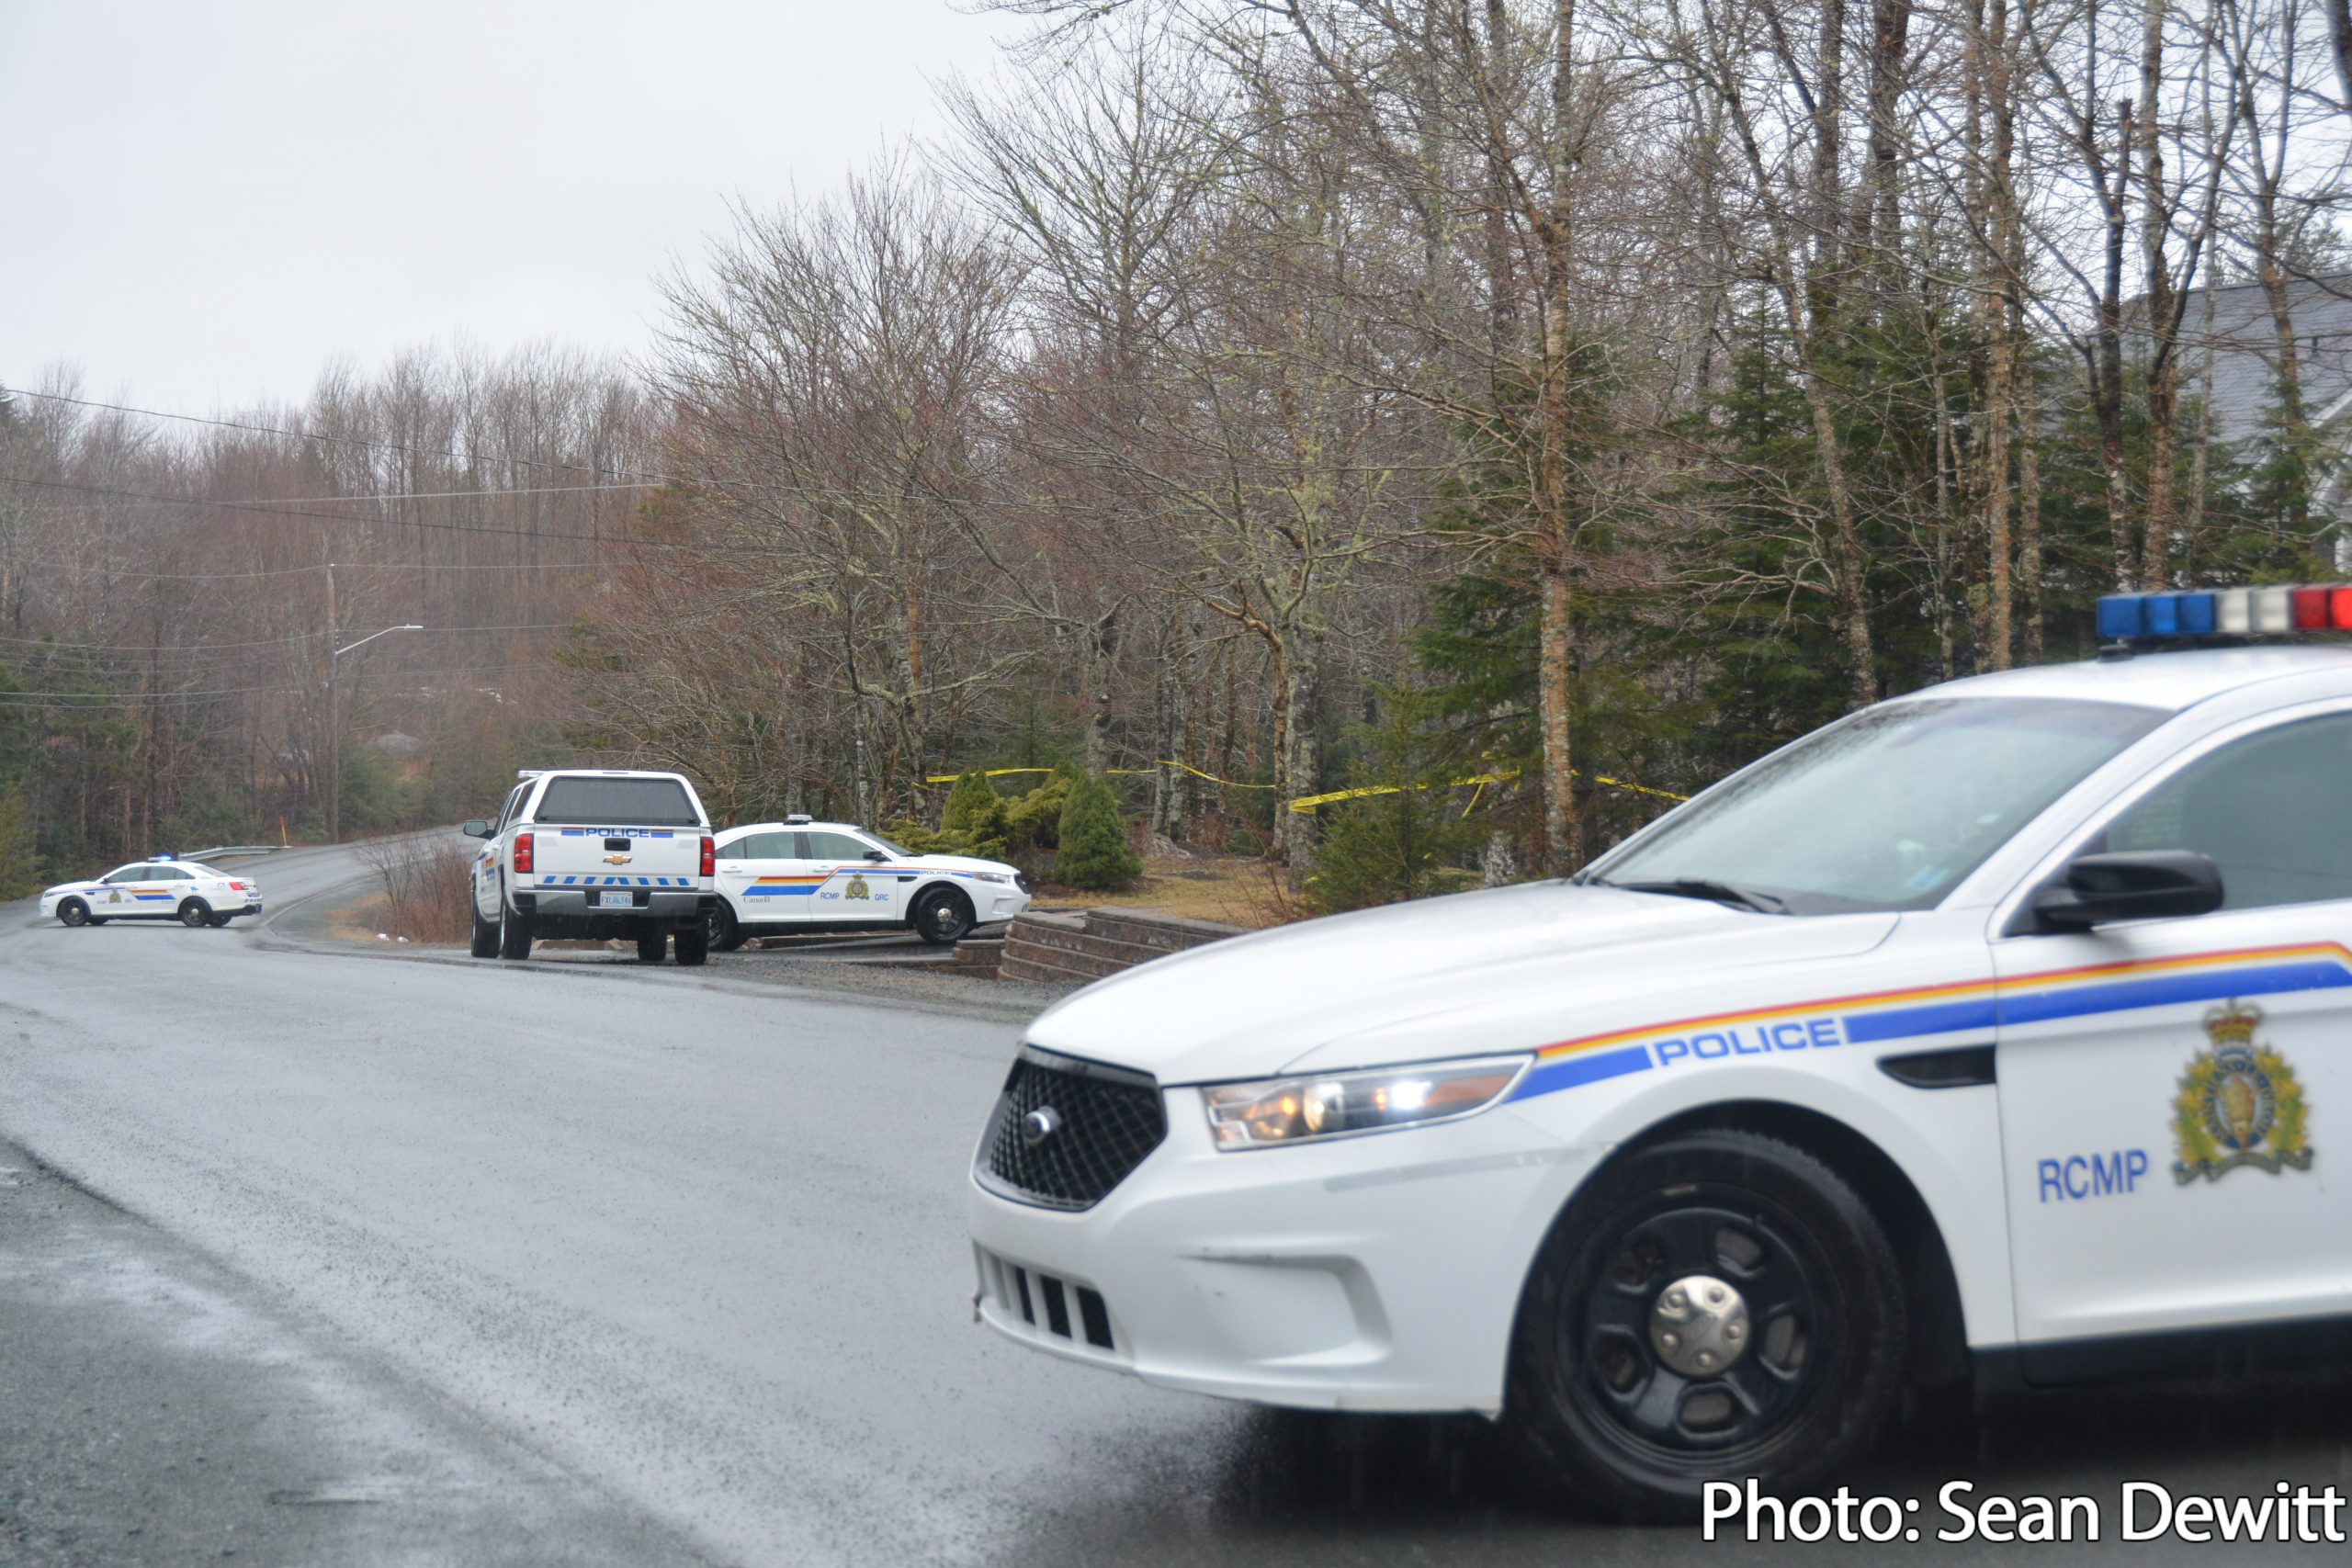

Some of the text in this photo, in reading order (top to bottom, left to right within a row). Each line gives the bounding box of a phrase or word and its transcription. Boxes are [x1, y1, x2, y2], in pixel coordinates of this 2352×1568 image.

[585, 827, 650, 837] POLICE
[820, 892, 840, 900] RCMP
[1654, 1018, 1840, 1066] POLICE
[2038, 1148, 2148, 1202] RCMP
